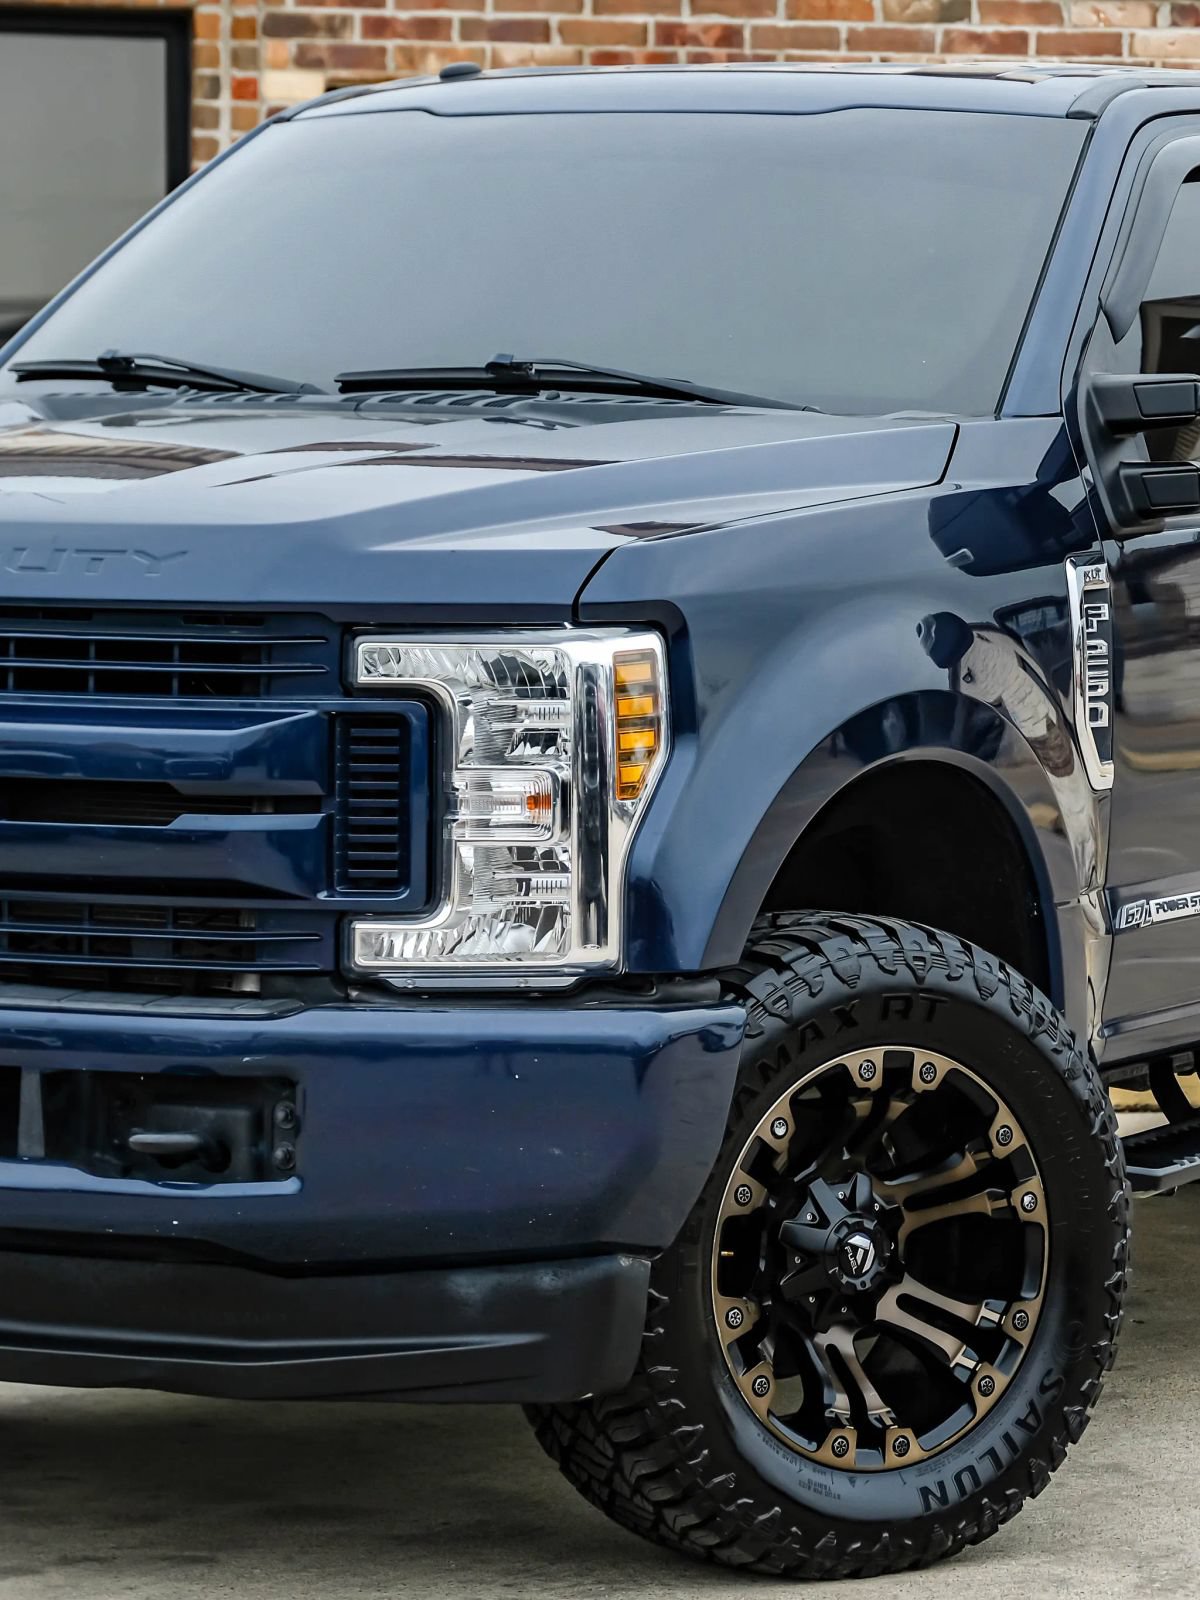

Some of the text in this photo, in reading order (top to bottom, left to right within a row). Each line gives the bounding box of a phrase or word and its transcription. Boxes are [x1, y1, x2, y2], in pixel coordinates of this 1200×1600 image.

[1154, 897, 1189, 915] POWER
[844, 1246, 858, 1275] FUEL
[918, 1367, 1067, 1514] SAILUN
